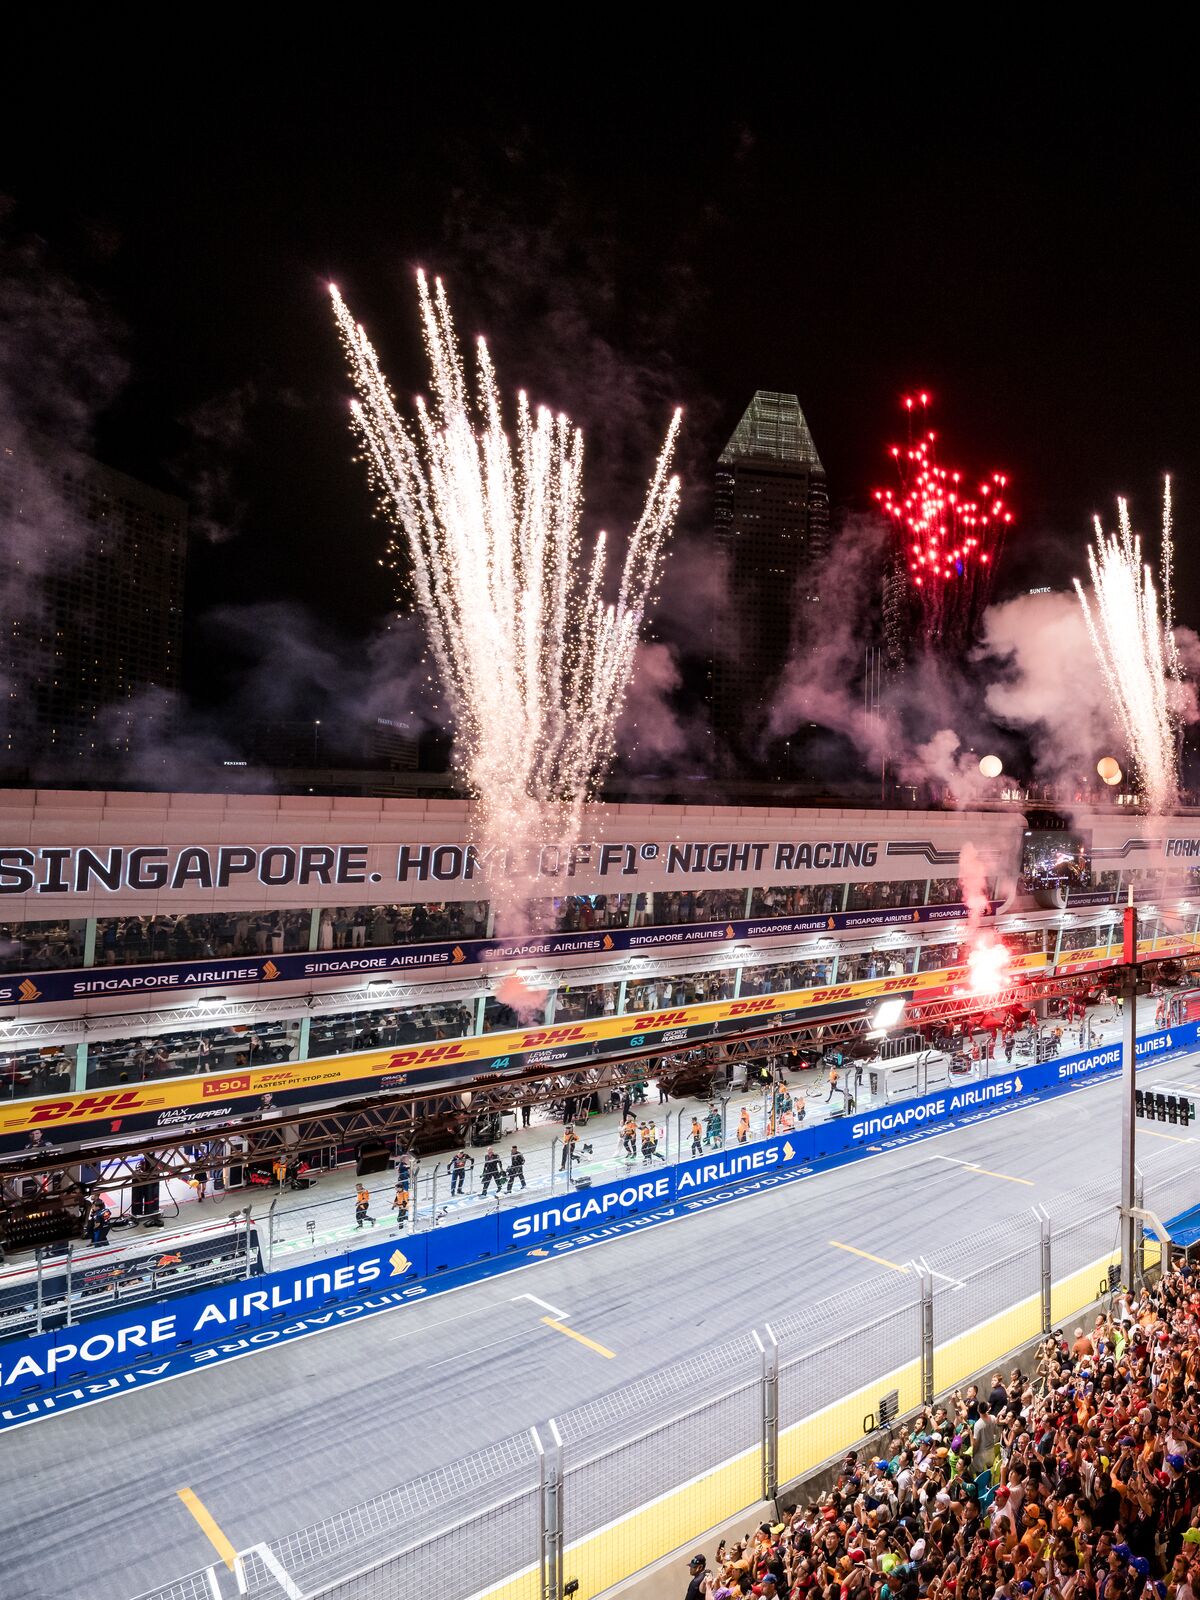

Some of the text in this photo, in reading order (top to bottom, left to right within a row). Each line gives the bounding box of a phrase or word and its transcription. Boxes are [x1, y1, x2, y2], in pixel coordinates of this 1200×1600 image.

[0, 845, 383, 894] SINGAPORE.
[666, 842, 770, 873] NIGHT
[774, 841, 879, 871] RACING
[845, 914, 912, 926] SINGAPORE AIRLINES
[928, 910, 961, 919] SINGAPORE
[747, 921, 827, 935] SINGAPORE AIRLINES
[629, 929, 724, 945] SINGAPORE AIRLINES
[484, 940, 601, 957] SINGAPORE AIRLINES
[1069, 950, 1096, 961] DHL
[304, 952, 449, 973] SINGAPORE AIRLINES
[73, 968, 258, 993] SINGAPORE AIRLINES
[947, 967, 972, 981] DH
[883, 976, 920, 992] DHL
[811, 987, 855, 1003] DHL
[729, 999, 778, 1016] DHL
[633, 1011, 690, 1031] DHL
[521, 1026, 588, 1048] DHL
[661, 1032, 688, 1043] RUSSELL
[662, 1028, 689, 1037] GEORGE
[629, 1036, 646, 1047] 63
[387, 1044, 468, 1069] DHL
[527, 1052, 568, 1064] HAMILTON
[529, 1049, 553, 1060] LEWIS
[1058, 1049, 1121, 1078] SINGAPORE
[1135, 1035, 1166, 1055] RLINES
[490, 1057, 510, 1069] 44
[253, 1071, 341, 1090] FASTEST PIT STOP 2024
[260, 1072, 294, 1082] DHL
[205, 1080, 248, 1094] 1.90s
[28, 1091, 148, 1124] DHL
[159, 1107, 190, 1119] MAX
[852, 1081, 1013, 1139] SINGAPORE AIRLINES
[156, 1107, 233, 1126] VERSTAPPEN
[110, 1119, 123, 1132] 1
[512, 1177, 670, 1239] SINGAPORE
[677, 1146, 779, 1191] AIRLINES
[553, 1166, 814, 1250] SINGAPORE AIRLINES
[0, 1257, 381, 1387] APORE AIRLINES
[190, 1285, 427, 1363] SINGAPORE
